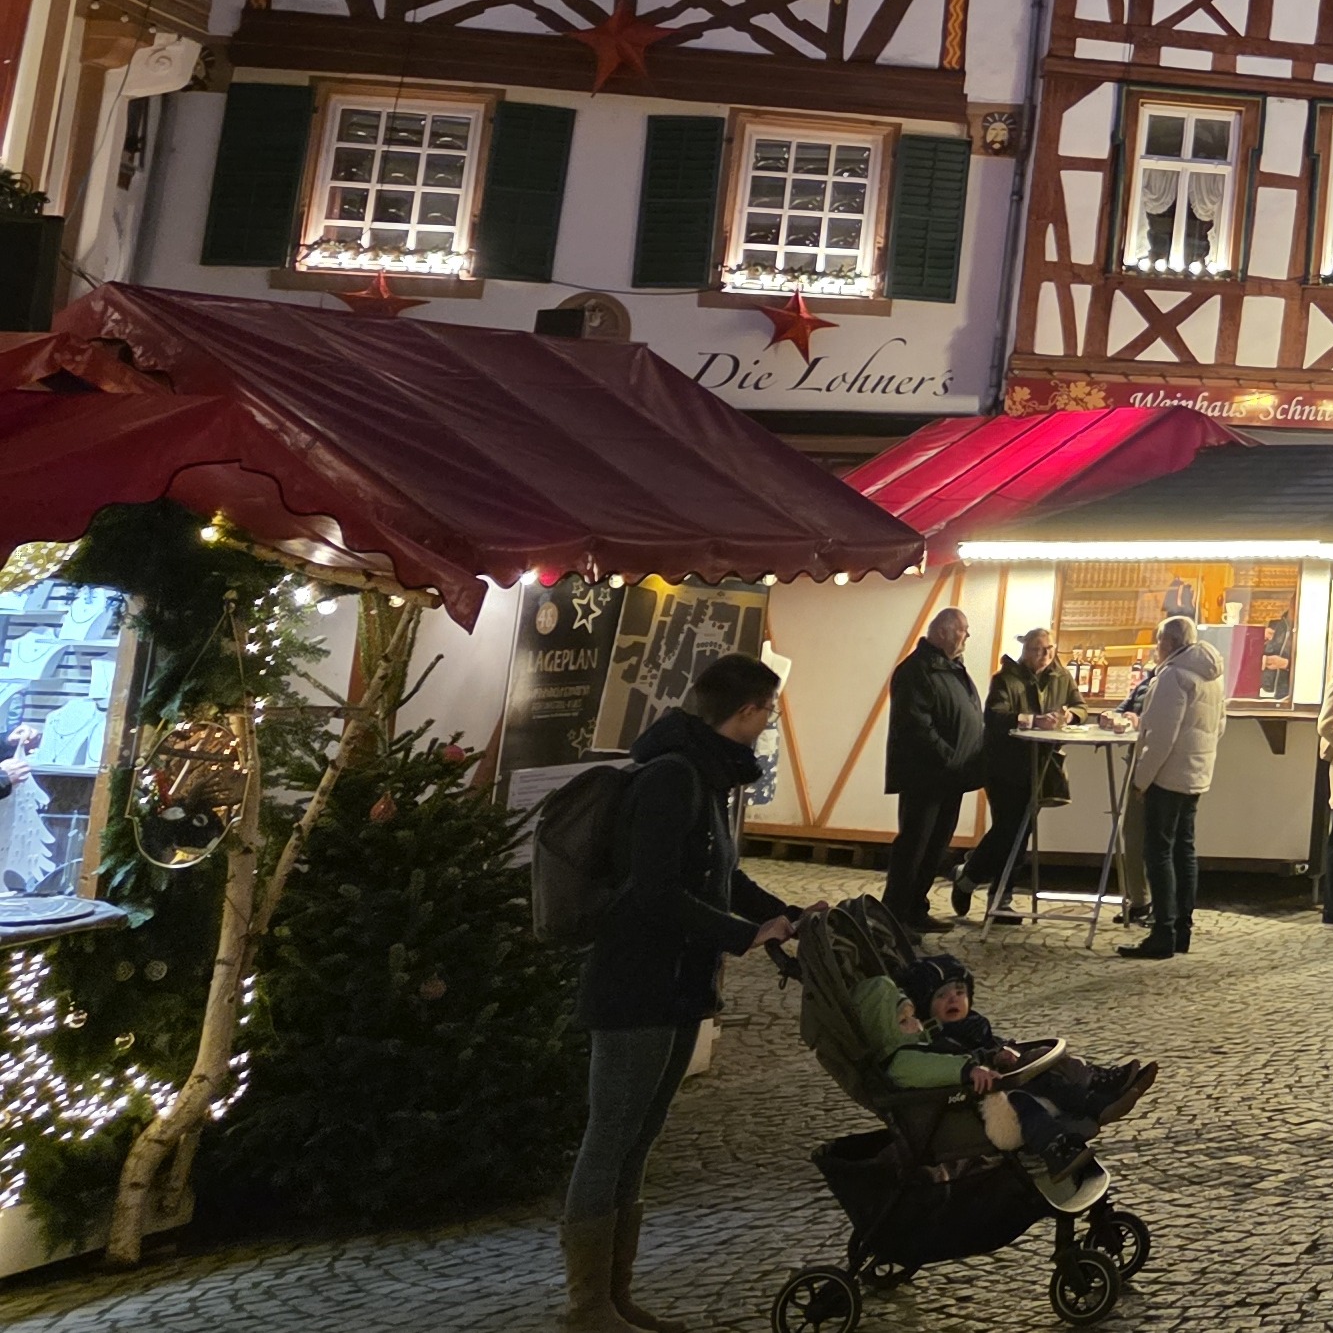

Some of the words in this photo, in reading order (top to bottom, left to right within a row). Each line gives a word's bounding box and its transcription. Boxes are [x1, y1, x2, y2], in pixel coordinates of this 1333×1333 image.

[693, 351, 779, 390] Die
[786, 337, 954, 397] Lohner's
[528, 649, 598, 672] LAGEPLAN
